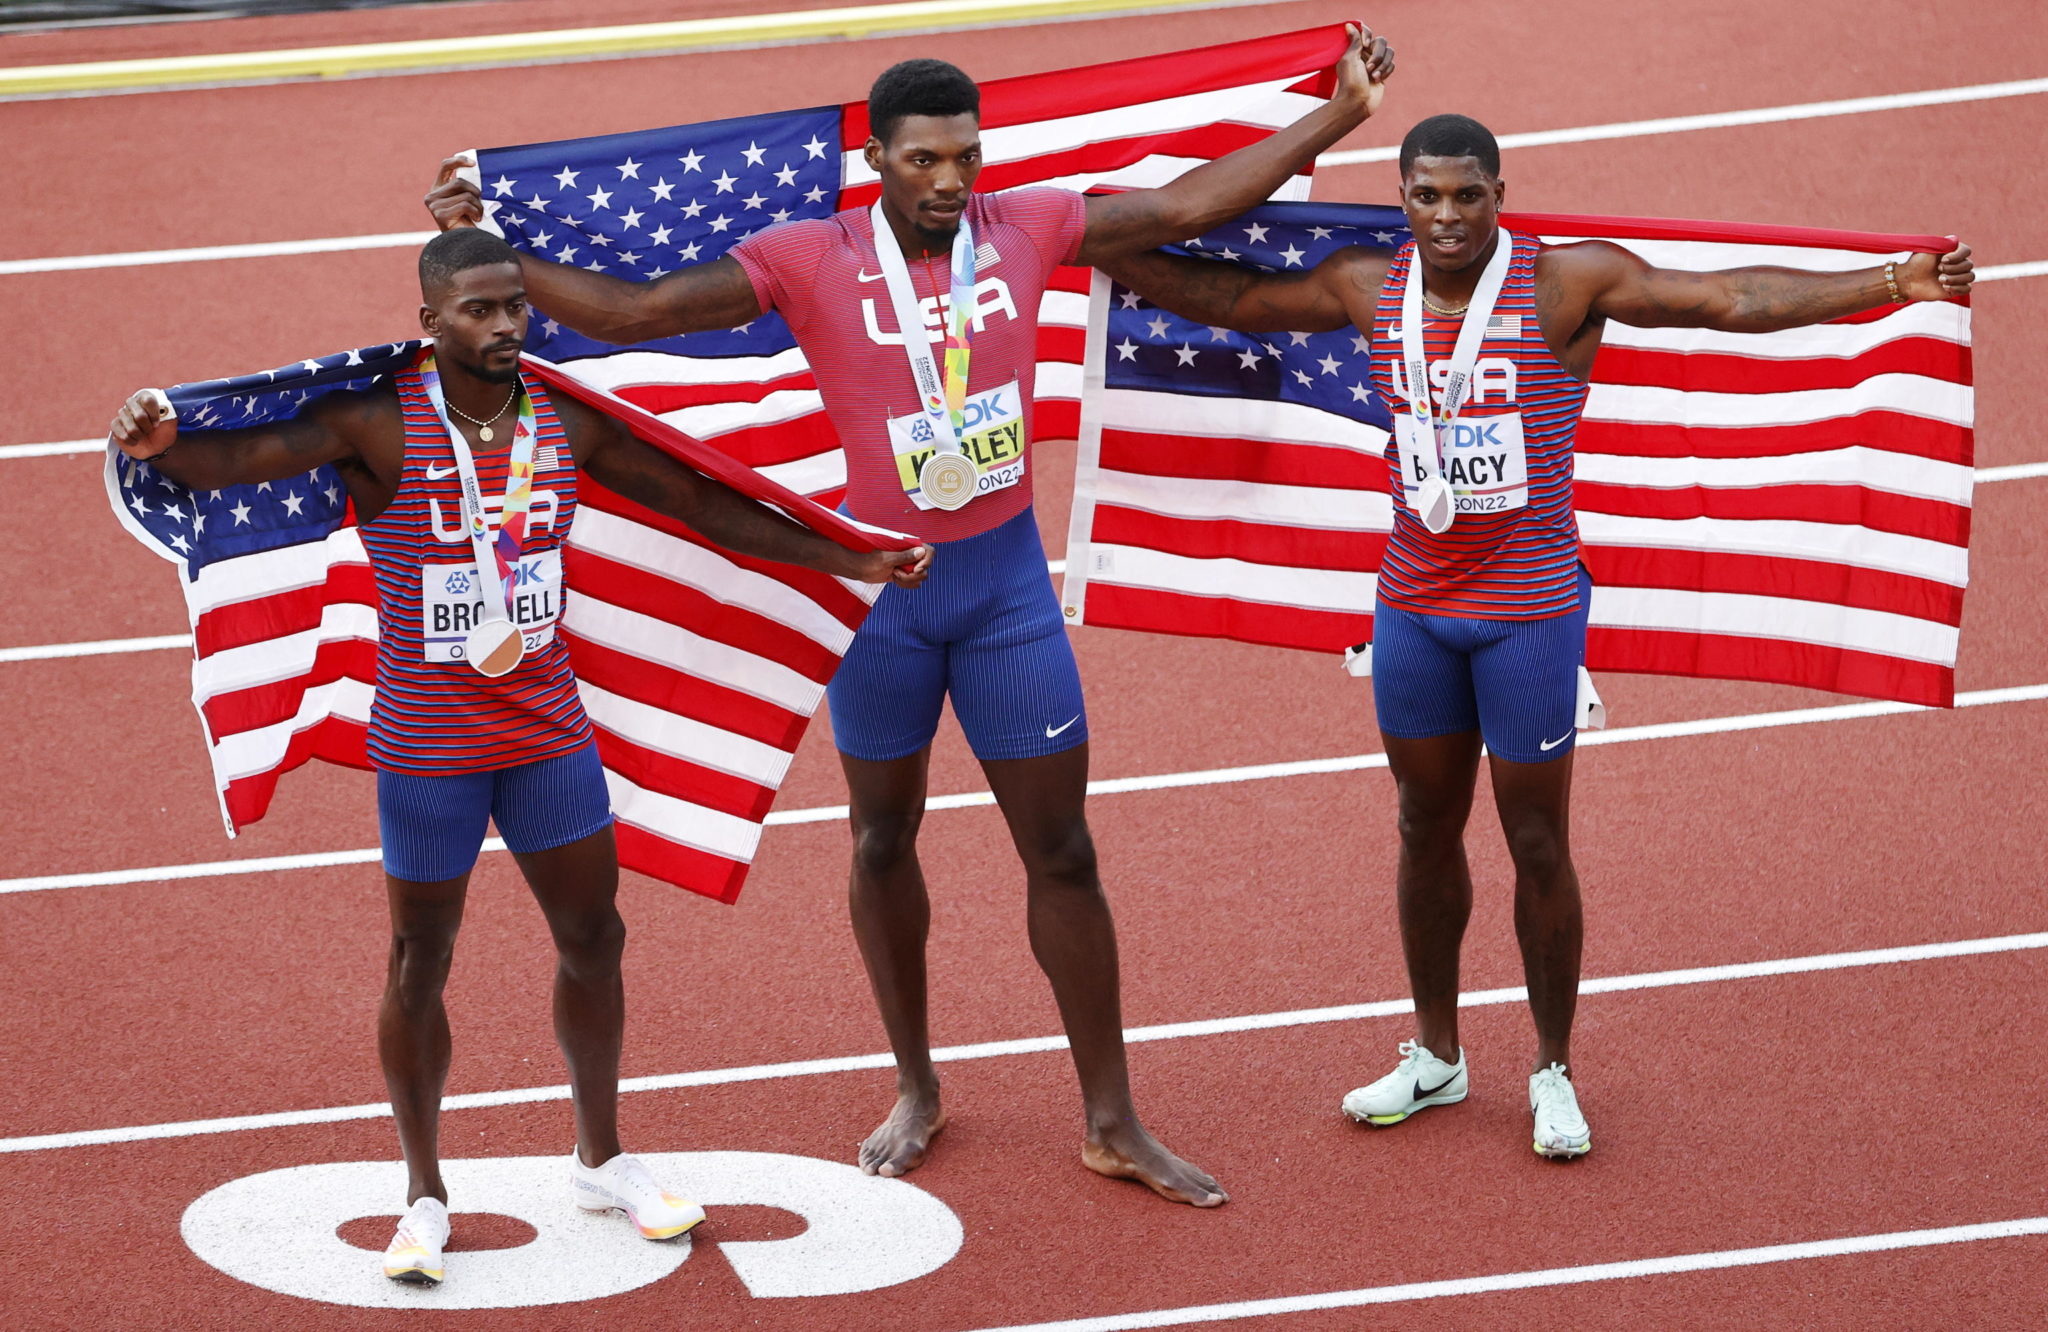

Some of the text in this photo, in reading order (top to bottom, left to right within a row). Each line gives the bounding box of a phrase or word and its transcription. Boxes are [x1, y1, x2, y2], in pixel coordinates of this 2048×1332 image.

[861, 276, 1018, 345] USA
[1391, 357, 1517, 404] USA
[963, 393, 1009, 429] DK
[911, 422, 1019, 484] KRLEY
[433, 590, 554, 632] BROELL
